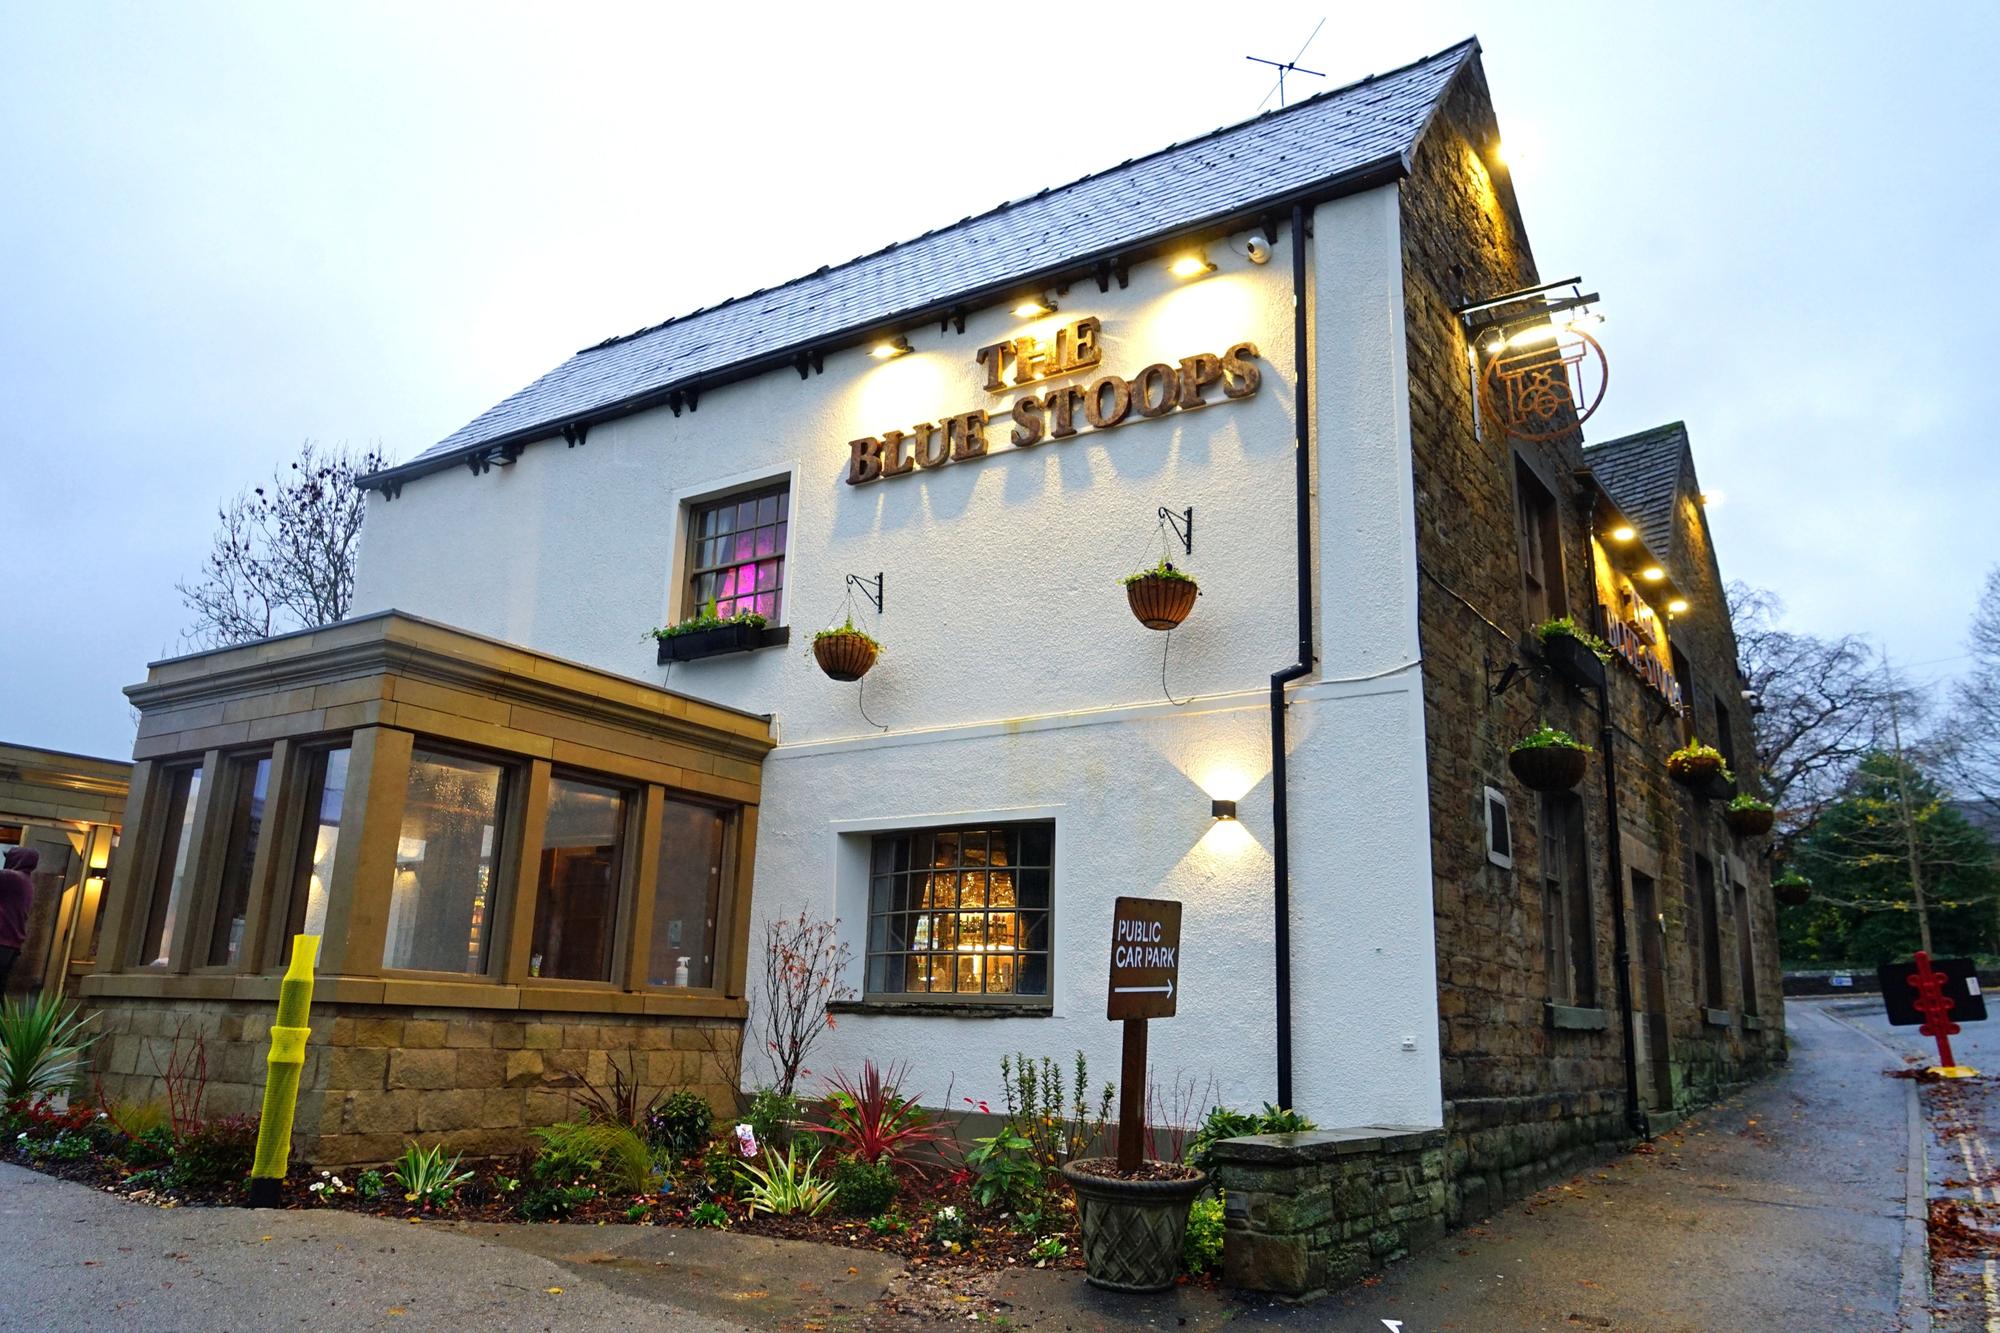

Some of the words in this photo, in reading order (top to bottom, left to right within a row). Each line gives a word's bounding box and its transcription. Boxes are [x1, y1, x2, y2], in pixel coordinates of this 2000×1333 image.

[976, 316, 1101, 392] THE
[846, 409, 989, 485] BLUE
[1010, 342, 1261, 447] STOOPS
[1118, 920, 1162, 942] PUBLIC
[1116, 945, 1143, 968] CAR
[1145, 946, 1175, 968] PARK
